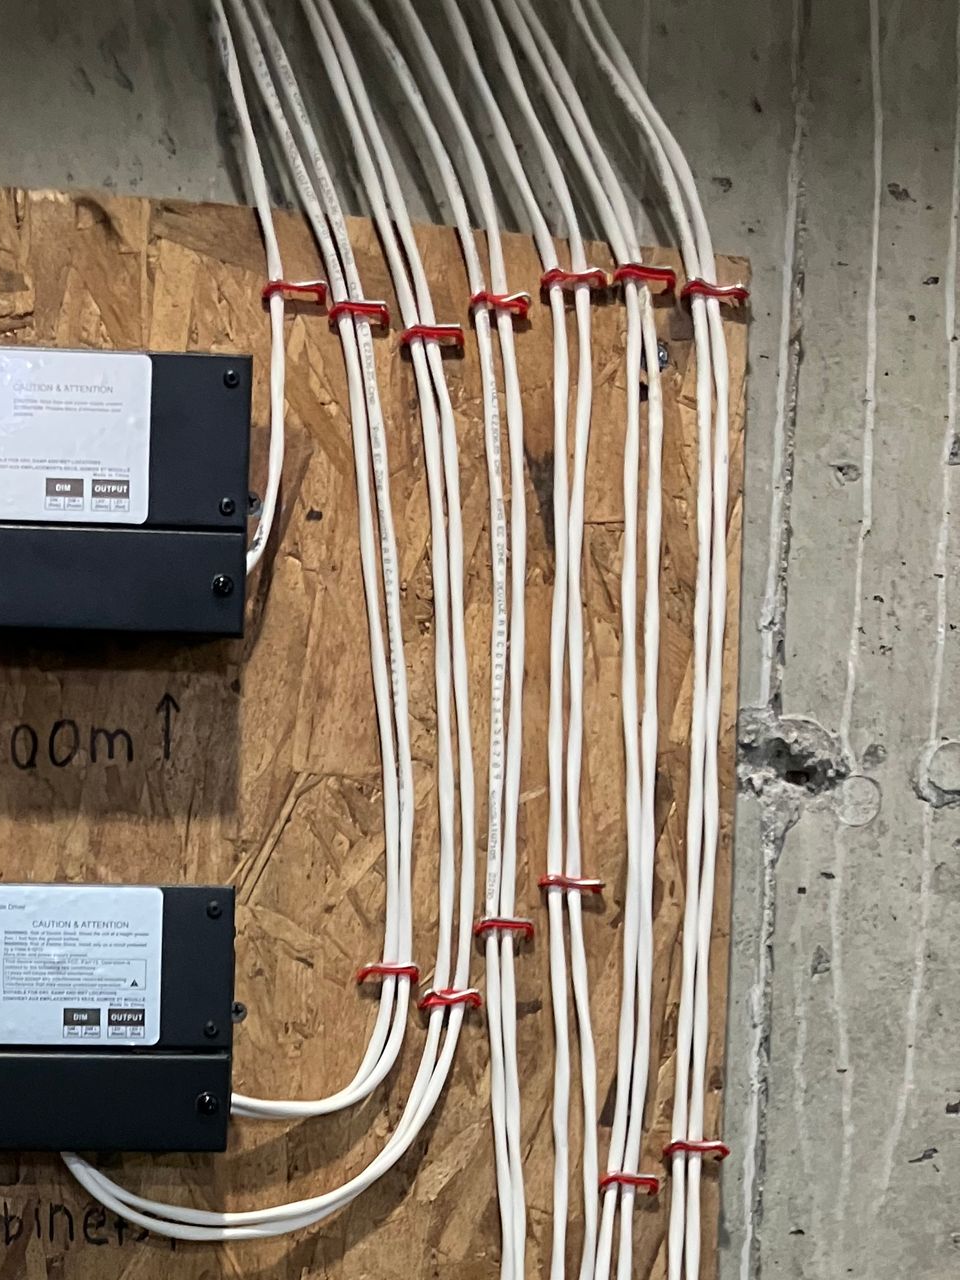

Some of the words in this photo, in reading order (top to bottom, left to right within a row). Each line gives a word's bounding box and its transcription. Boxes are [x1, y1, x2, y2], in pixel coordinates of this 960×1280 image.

[64, 384, 113, 393] ATTENTION
[32, 920, 71, 928] CAUTION
[81, 921, 129, 929] ATTENTION
